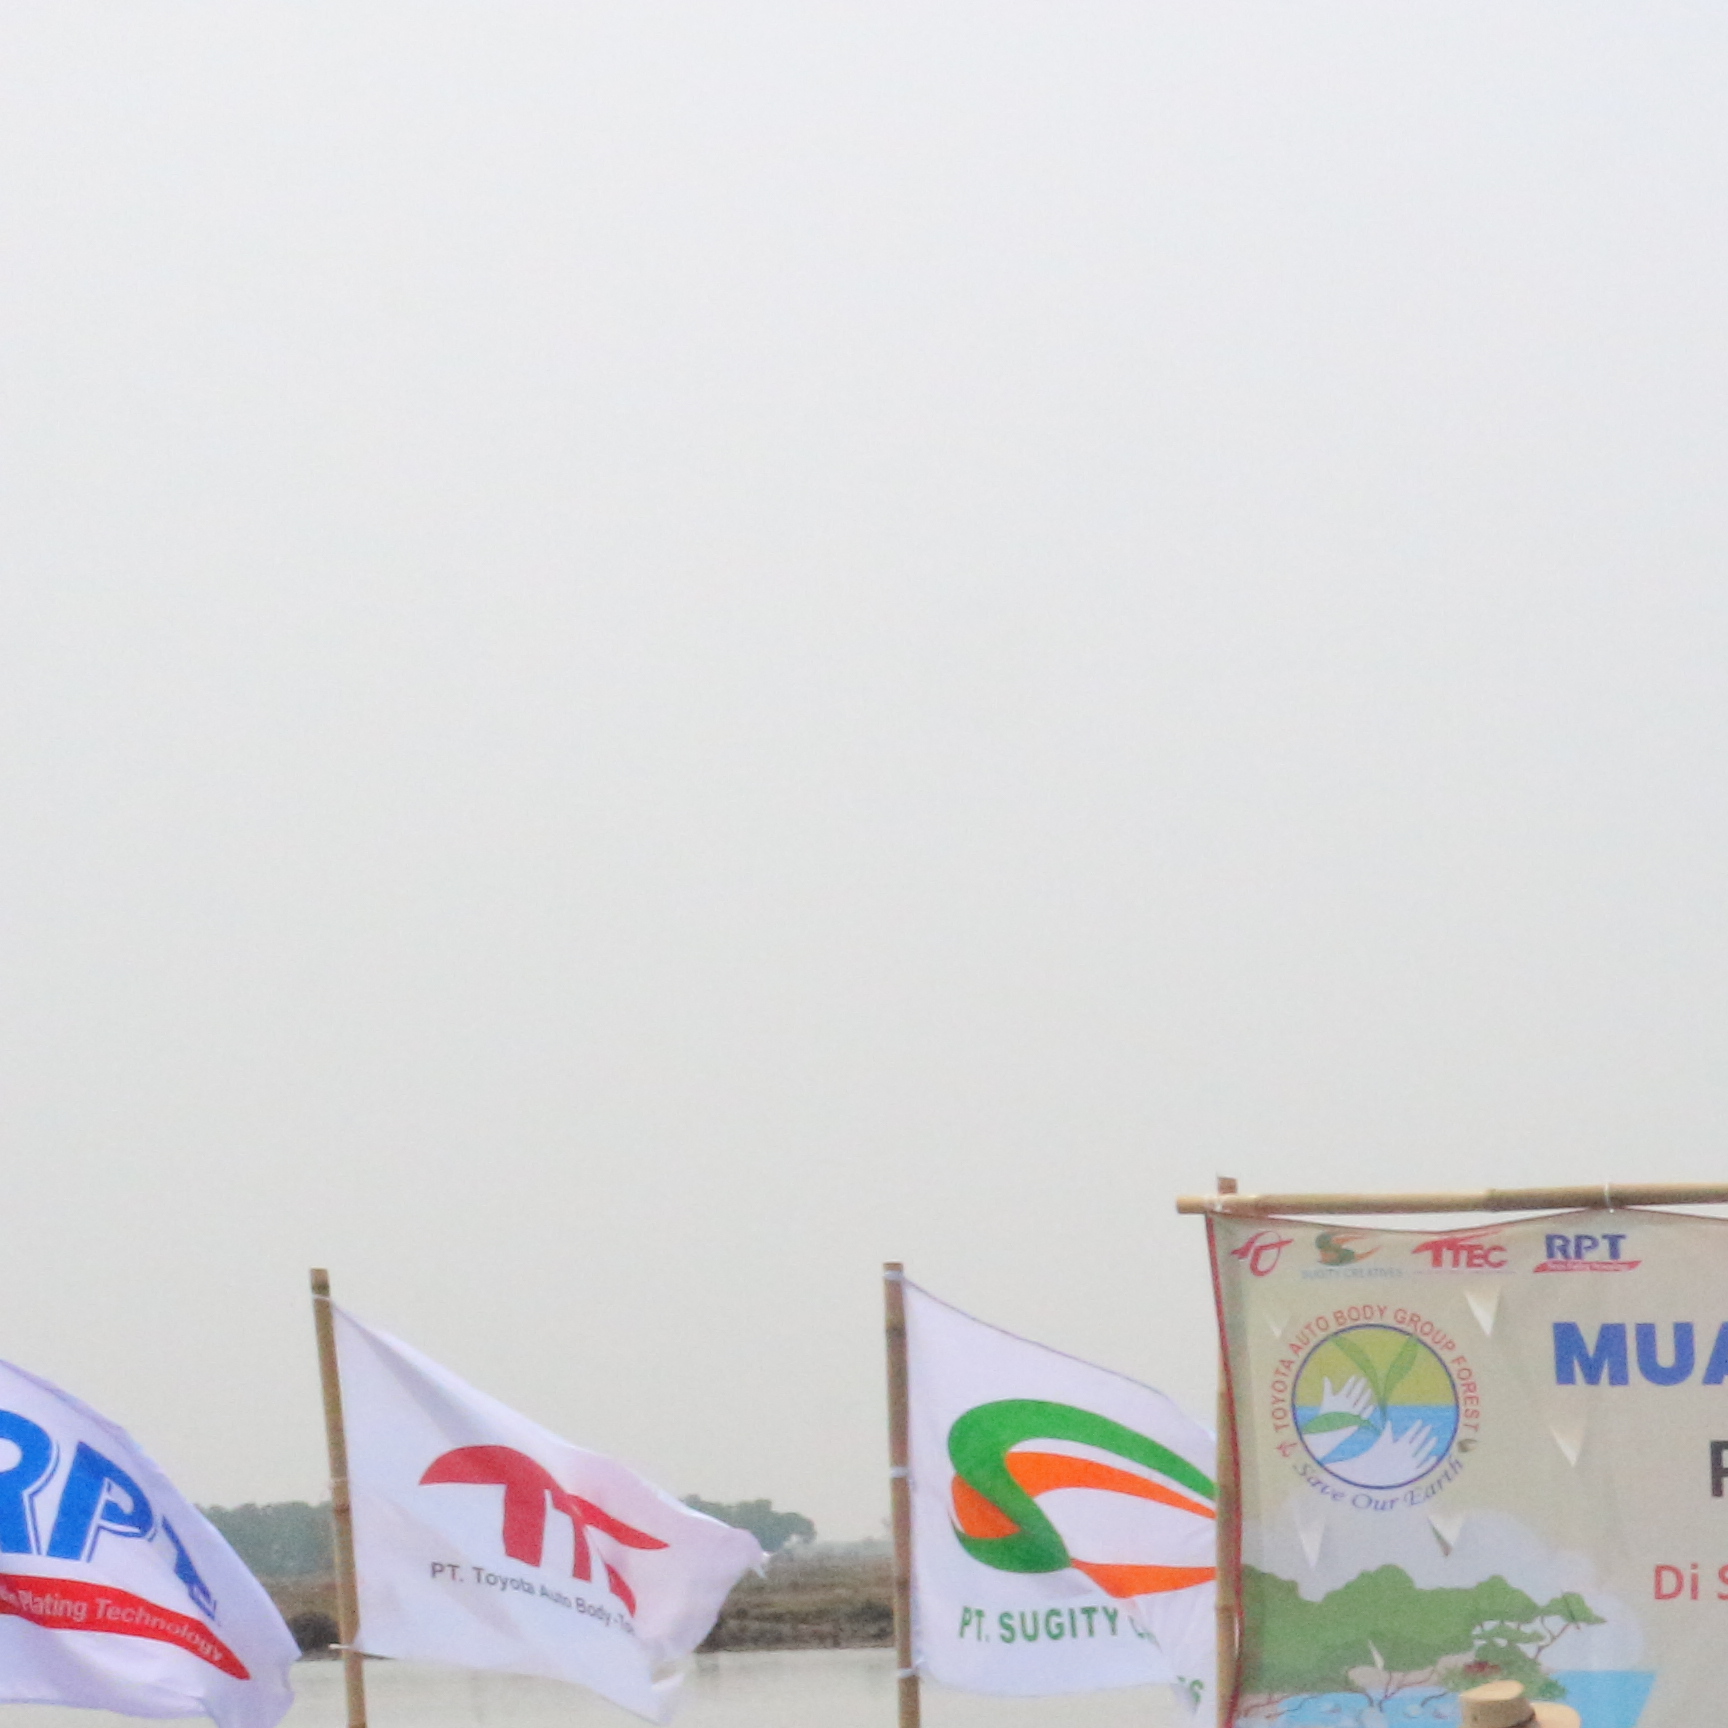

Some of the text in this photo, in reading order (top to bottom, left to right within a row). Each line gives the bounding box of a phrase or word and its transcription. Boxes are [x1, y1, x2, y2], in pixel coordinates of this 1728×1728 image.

[1545, 1234, 1627, 1260] RPT
[1271, 1304, 1480, 1432] TOYOTA AUTO BODY GROUP FOREST
[1351, 1493, 1400, 1512] Our
[1403, 1457, 1465, 1507] Earth
[430, 1562, 464, 1583] PT.
[472, 1567, 535, 1597] Toyota
[1654, 1564, 1699, 1601] Di
[95, 1598, 223, 1661] Technology
[958, 1605, 1120, 1644] PT. SUGITY
